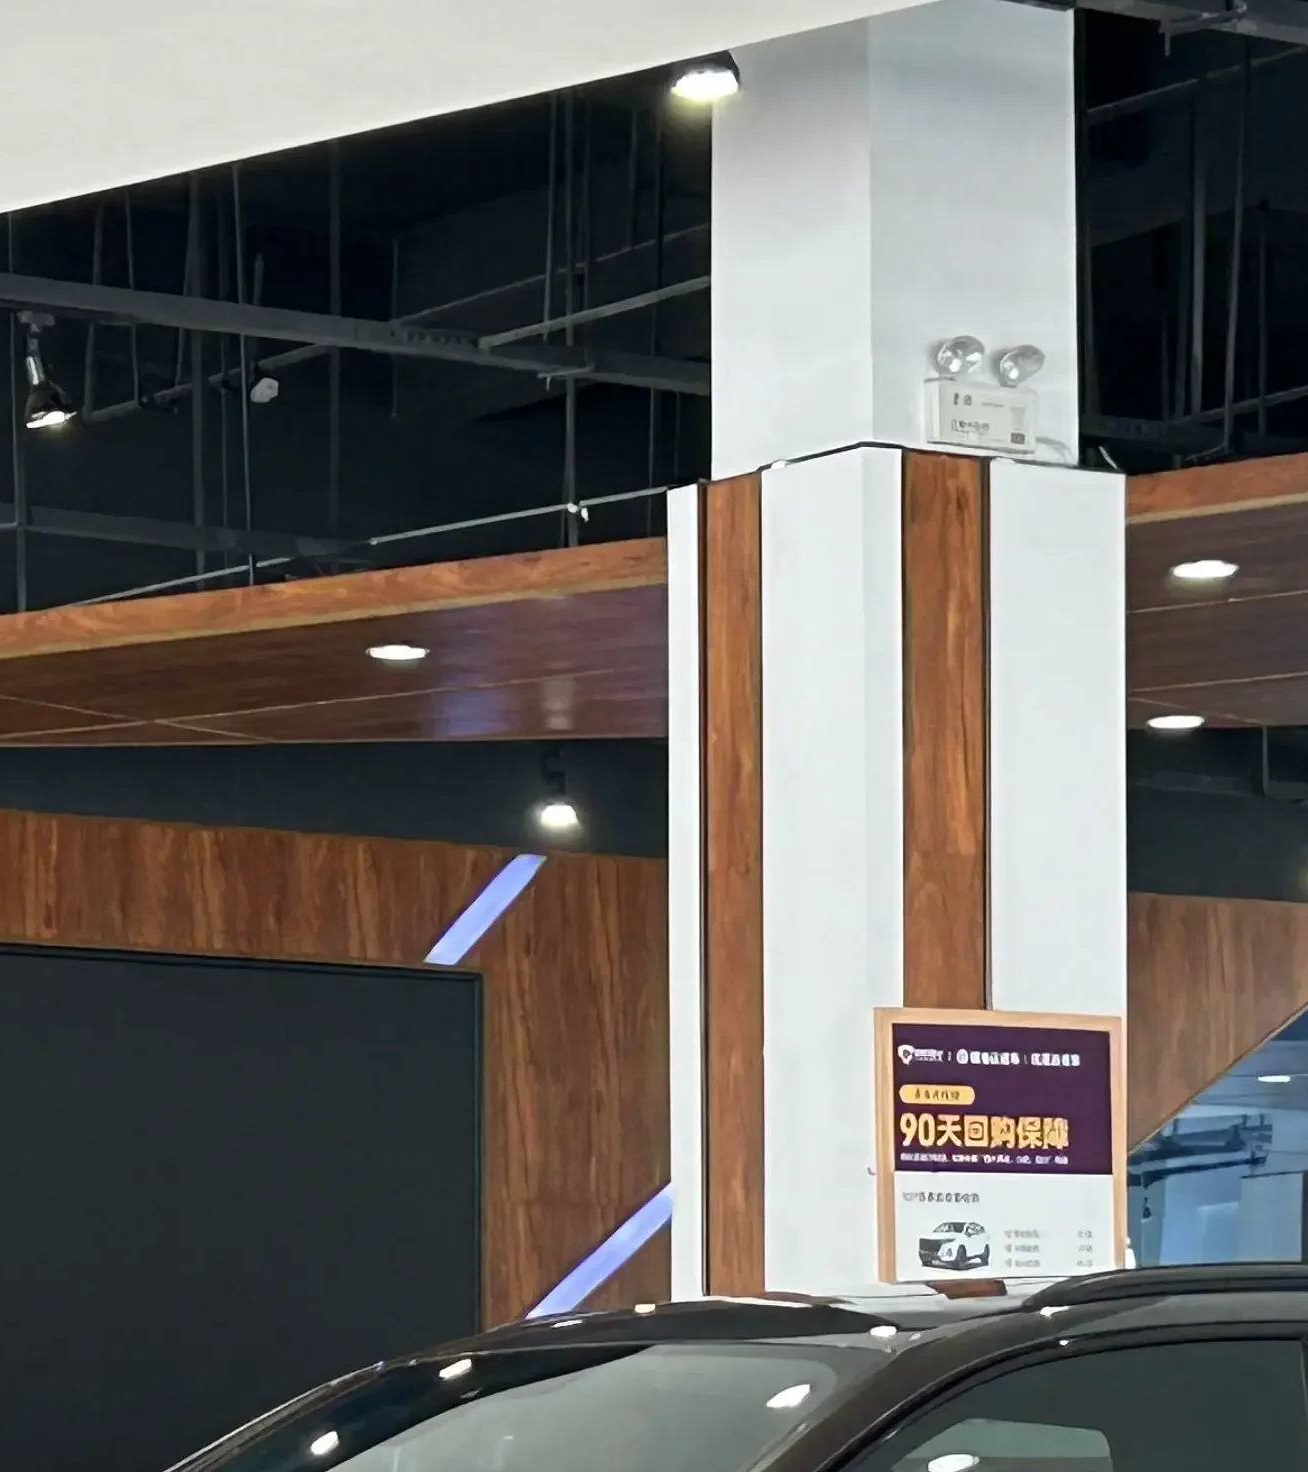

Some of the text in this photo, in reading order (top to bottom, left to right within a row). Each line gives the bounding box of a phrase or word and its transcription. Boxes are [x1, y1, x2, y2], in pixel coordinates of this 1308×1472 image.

[900, 1112, 1069, 1149] 90天回购保障
